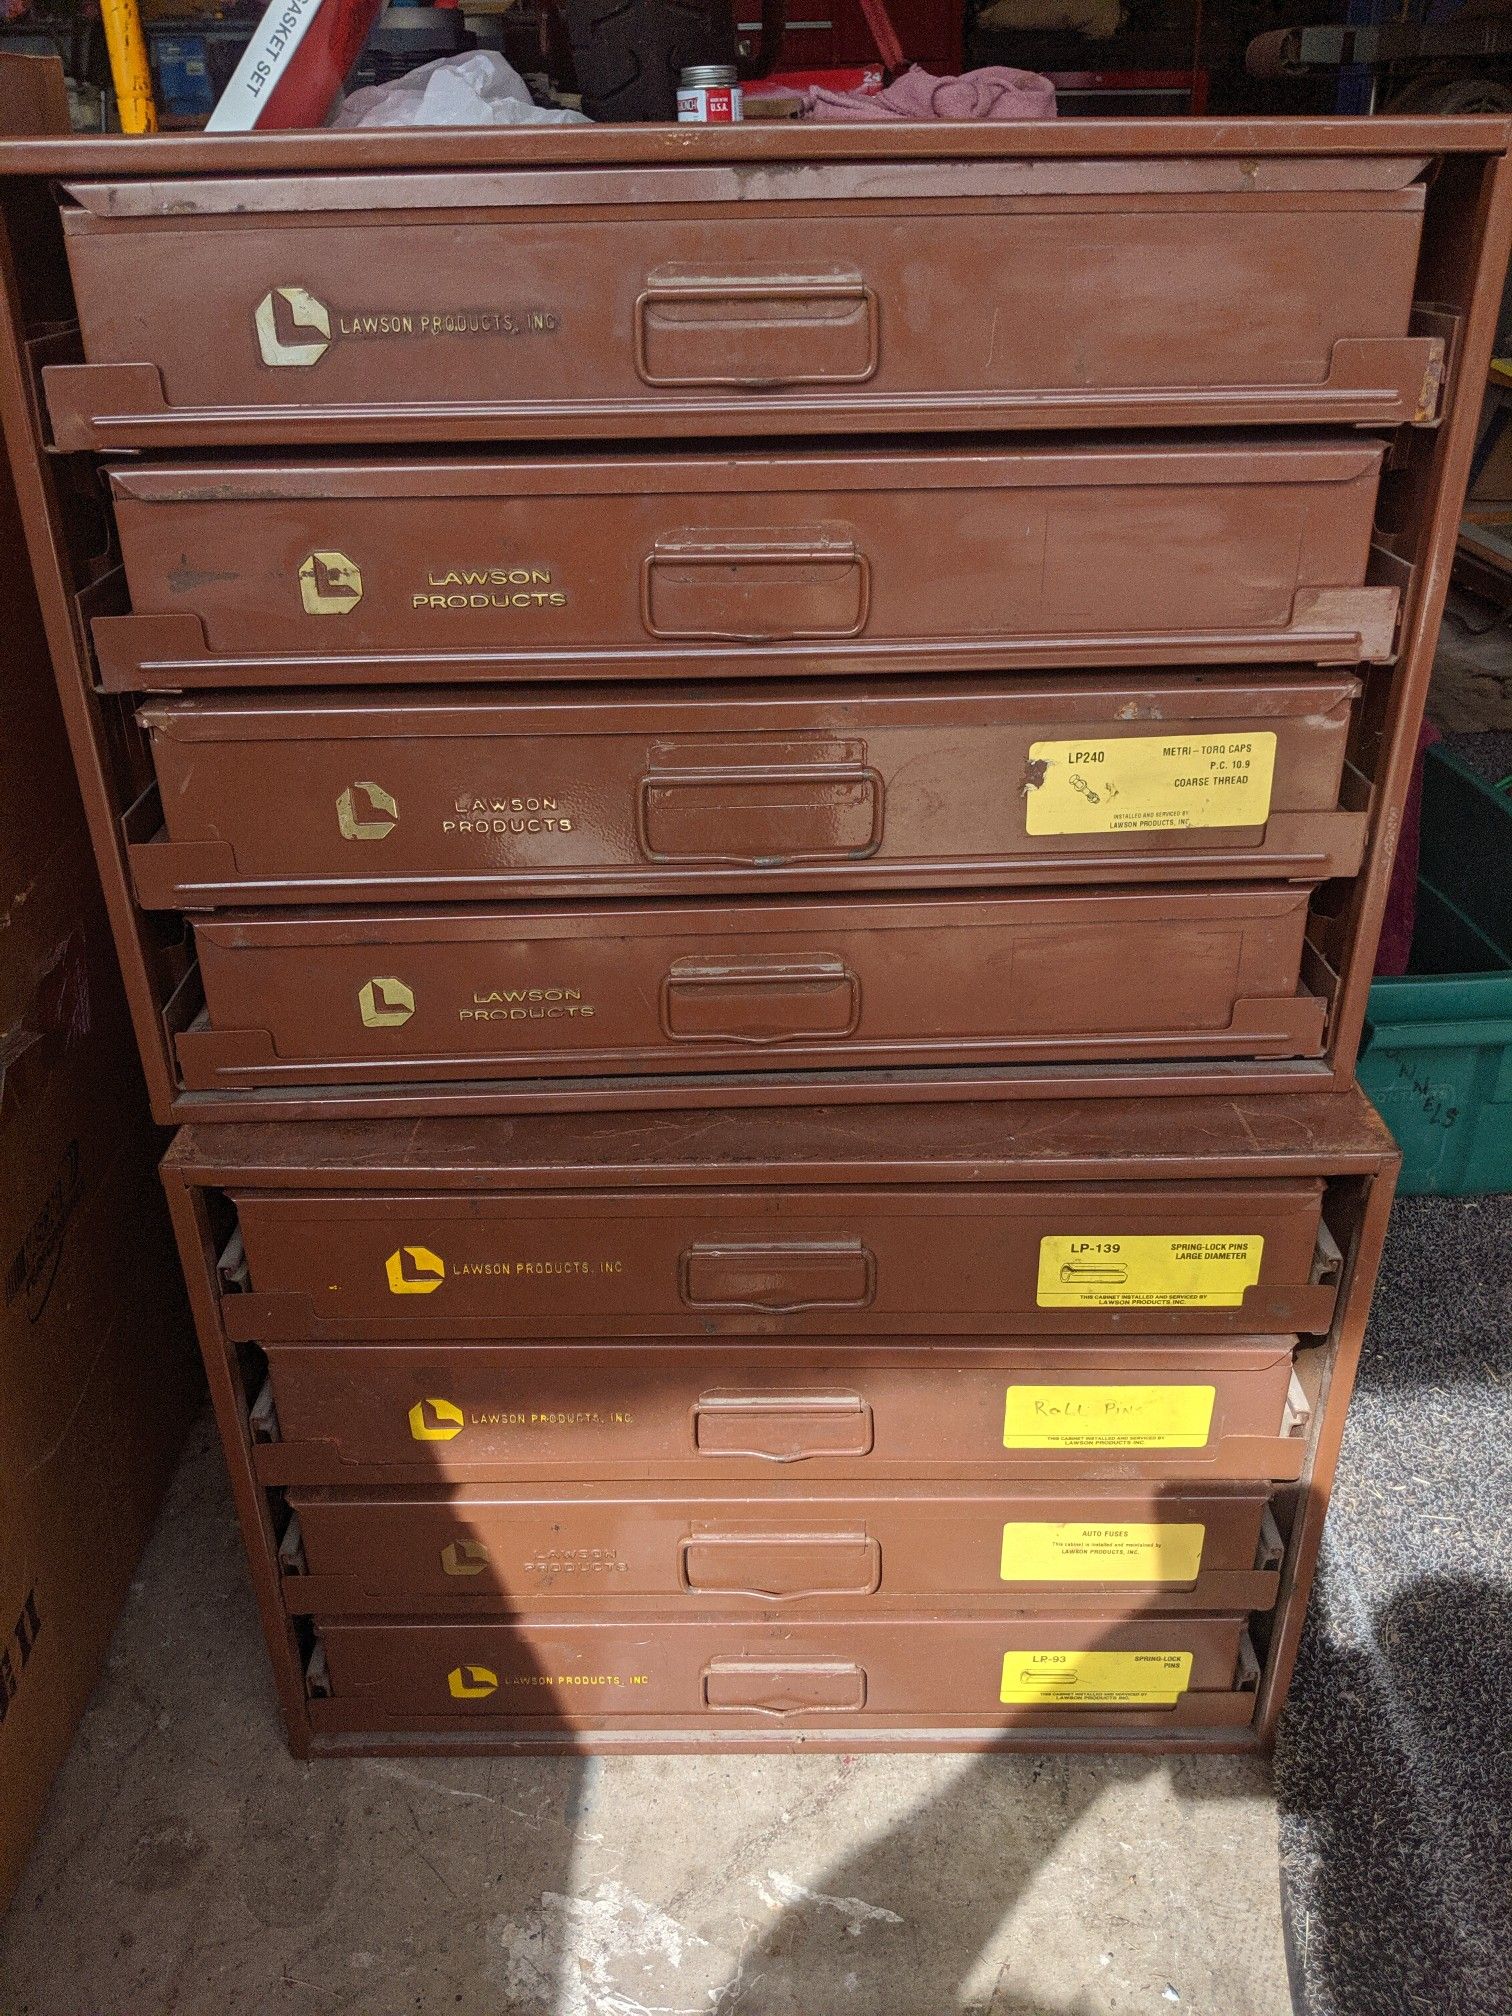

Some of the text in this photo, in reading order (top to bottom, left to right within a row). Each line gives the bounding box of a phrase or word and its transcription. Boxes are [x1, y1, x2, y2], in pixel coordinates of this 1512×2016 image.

[246, 0, 309, 97] ASKET SET
[340, 316, 413, 334] LAWSON
[428, 570, 551, 586] LAWSON
[412, 592, 567, 609] PRODUCTS
[1068, 751, 1105, 764] LP240
[1228, 744, 1252, 753] CAPS
[1210, 760, 1250, 770] P.C. 10.9
[1174, 775, 1249, 787] COARSE THREAD
[455, 798, 558, 813] LAWSON
[443, 818, 572, 833] PRODUCTS
[1109, 821, 1137, 829] LAWSON
[473, 988, 582, 1003] LAWSON
[459, 1006, 595, 1021] PRODUCTS
[1070, 1243, 1121, 1253] LP-139
[1170, 1243, 1227, 1251] SPRING-LOCK
[1204, 1252, 1247, 1260] DIAMETER
[453, 1264, 510, 1275] LAWSON
[471, 1414, 525, 1424] LAWSON
[534, 1549, 617, 1559] LAWSON
[523, 1562, 629, 1572] PRODUCTS
[505, 1676, 552, 1684] LAWSON
